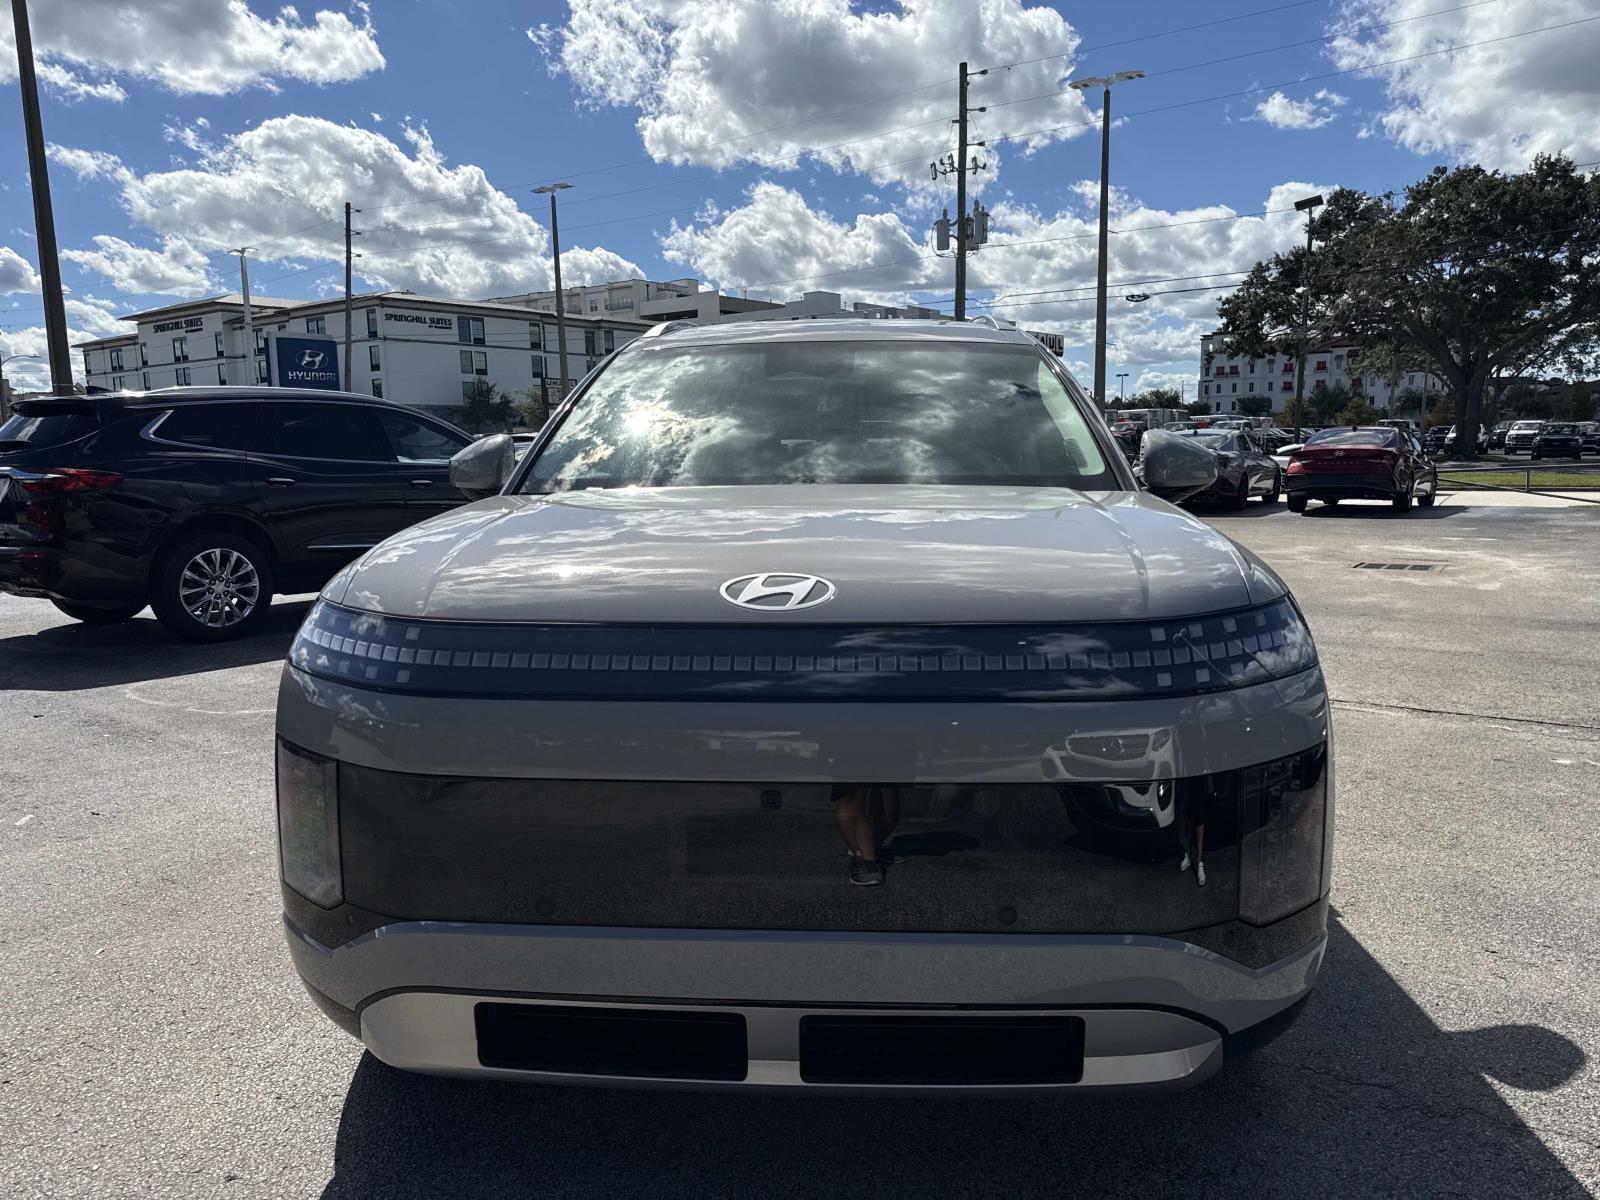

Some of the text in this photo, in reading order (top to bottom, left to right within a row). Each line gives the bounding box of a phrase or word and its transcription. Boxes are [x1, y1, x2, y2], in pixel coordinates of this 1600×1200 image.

[153, 320, 184, 333] SPRINGHILL
[184, 317, 203, 328] SUITES
[384, 313, 453, 326] SPRINGHILL SUITES
[288, 371, 336, 381] HYUNDAI
